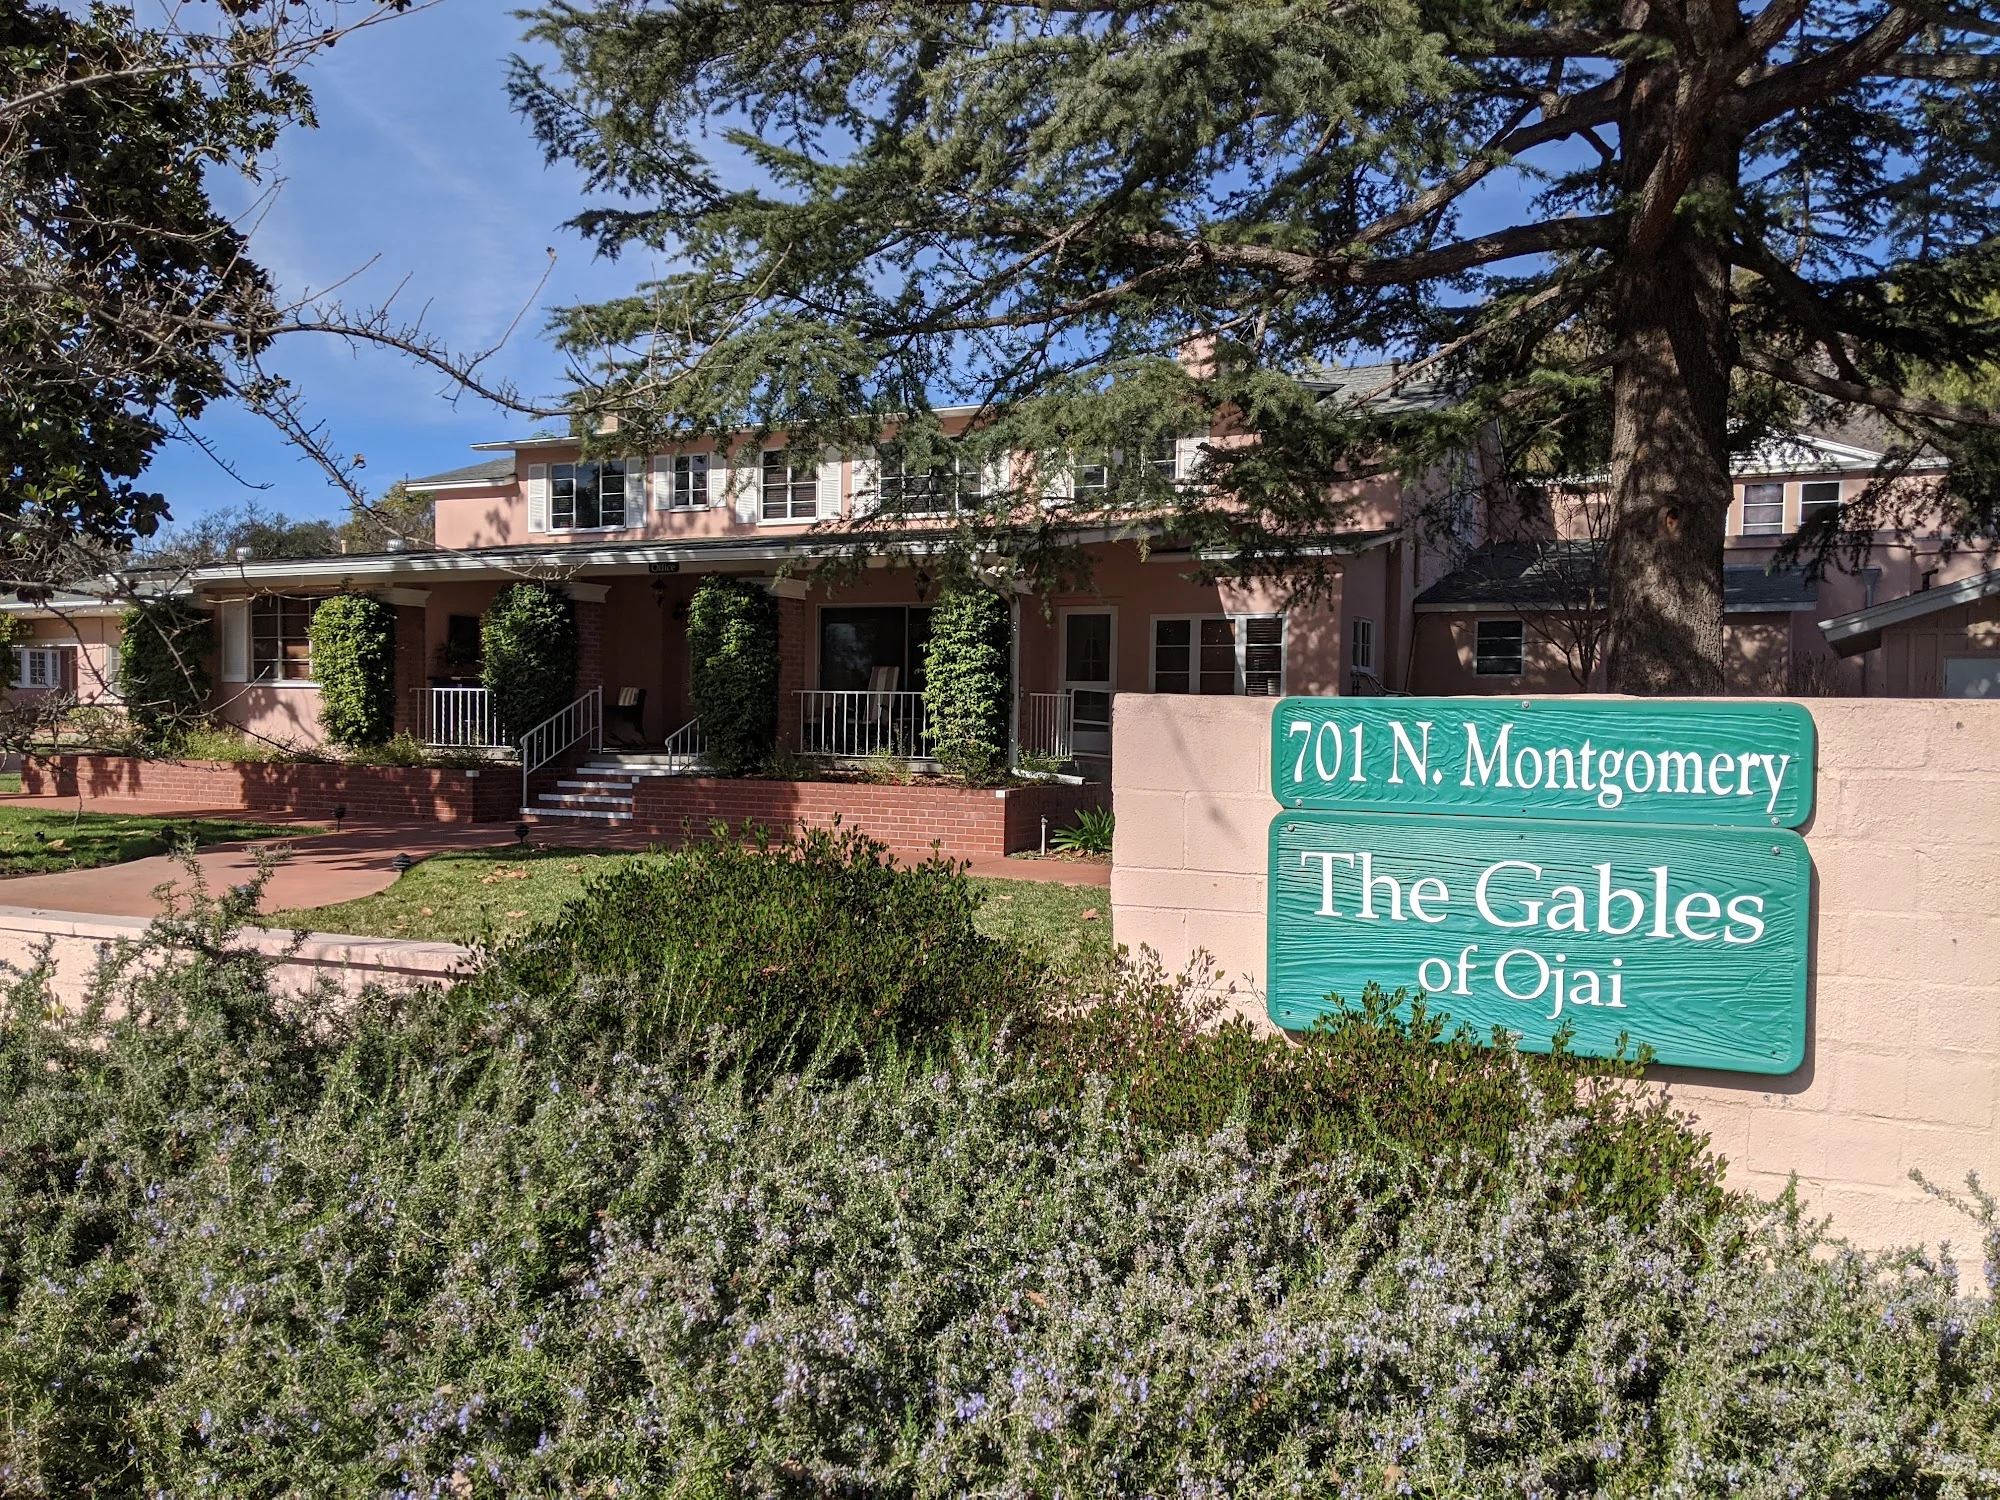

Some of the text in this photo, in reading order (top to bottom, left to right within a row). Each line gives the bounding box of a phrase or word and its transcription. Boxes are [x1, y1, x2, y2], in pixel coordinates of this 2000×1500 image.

[651, 563, 676, 572] Office
[1288, 720, 1792, 814] 701 N. Montgomery
[1300, 850, 1767, 945] The Gables
[1417, 944, 1627, 1020] of Ojai
